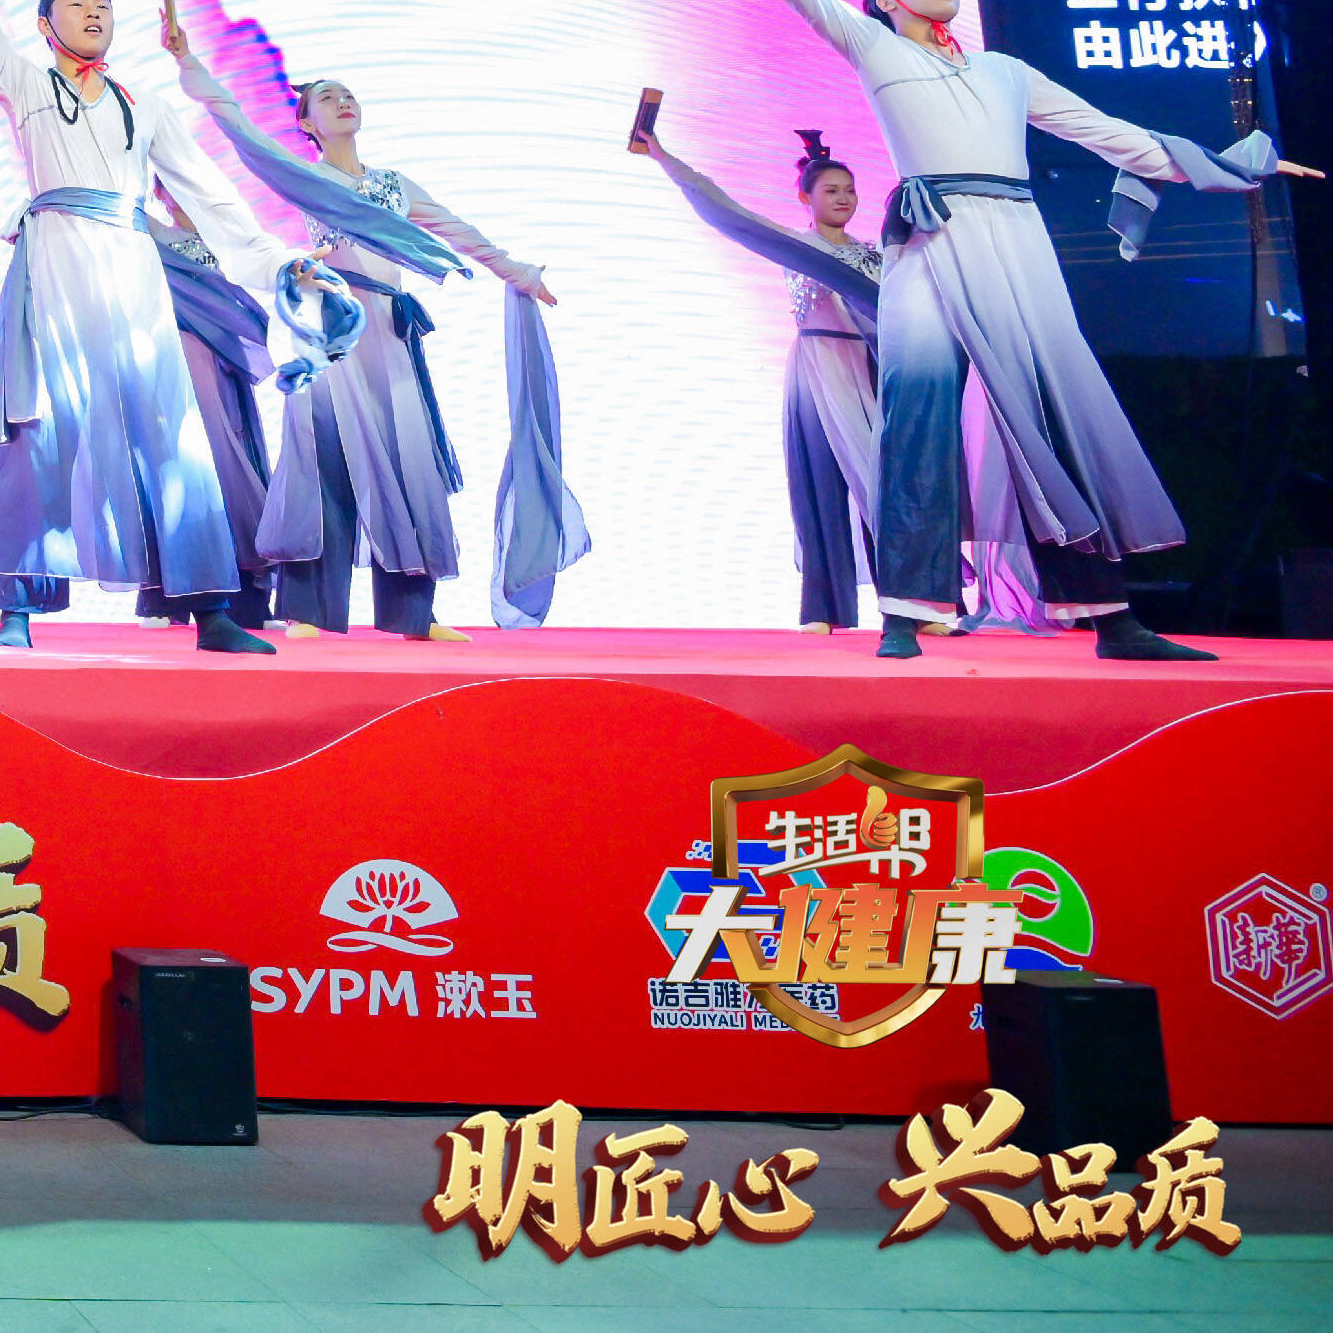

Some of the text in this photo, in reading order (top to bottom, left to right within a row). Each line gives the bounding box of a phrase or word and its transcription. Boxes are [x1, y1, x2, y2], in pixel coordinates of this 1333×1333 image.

[249, 966, 538, 1019] SYPM 漱玉
[652, 1011, 746, 1029] NUOJIYALI
